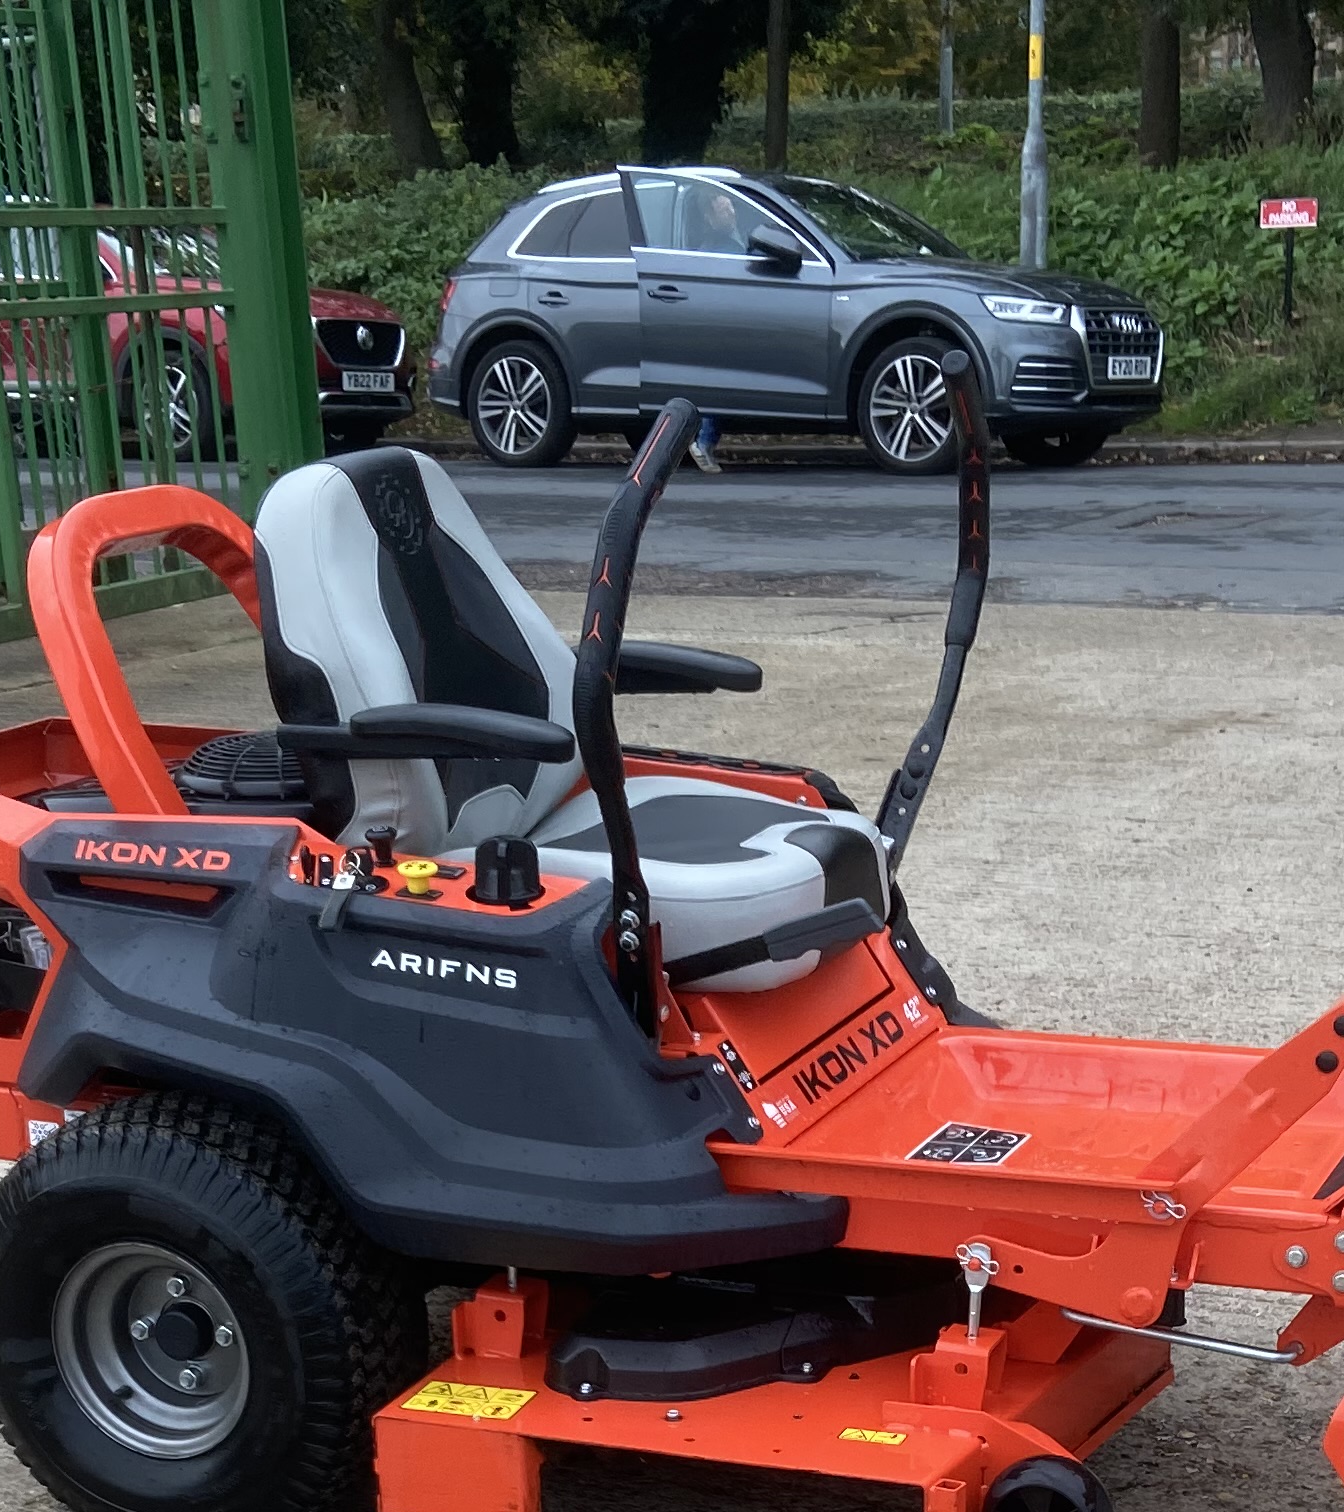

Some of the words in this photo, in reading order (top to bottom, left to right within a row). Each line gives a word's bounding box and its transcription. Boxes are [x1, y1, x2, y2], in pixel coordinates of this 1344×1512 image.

[1281, 200, 1296, 213] NO
[346, 373, 371, 388] YB22
[74, 839, 166, 867] IKON
[172, 847, 231, 871] XD
[792, 1035, 868, 1105] IKON
[857, 1010, 904, 1058] XD
